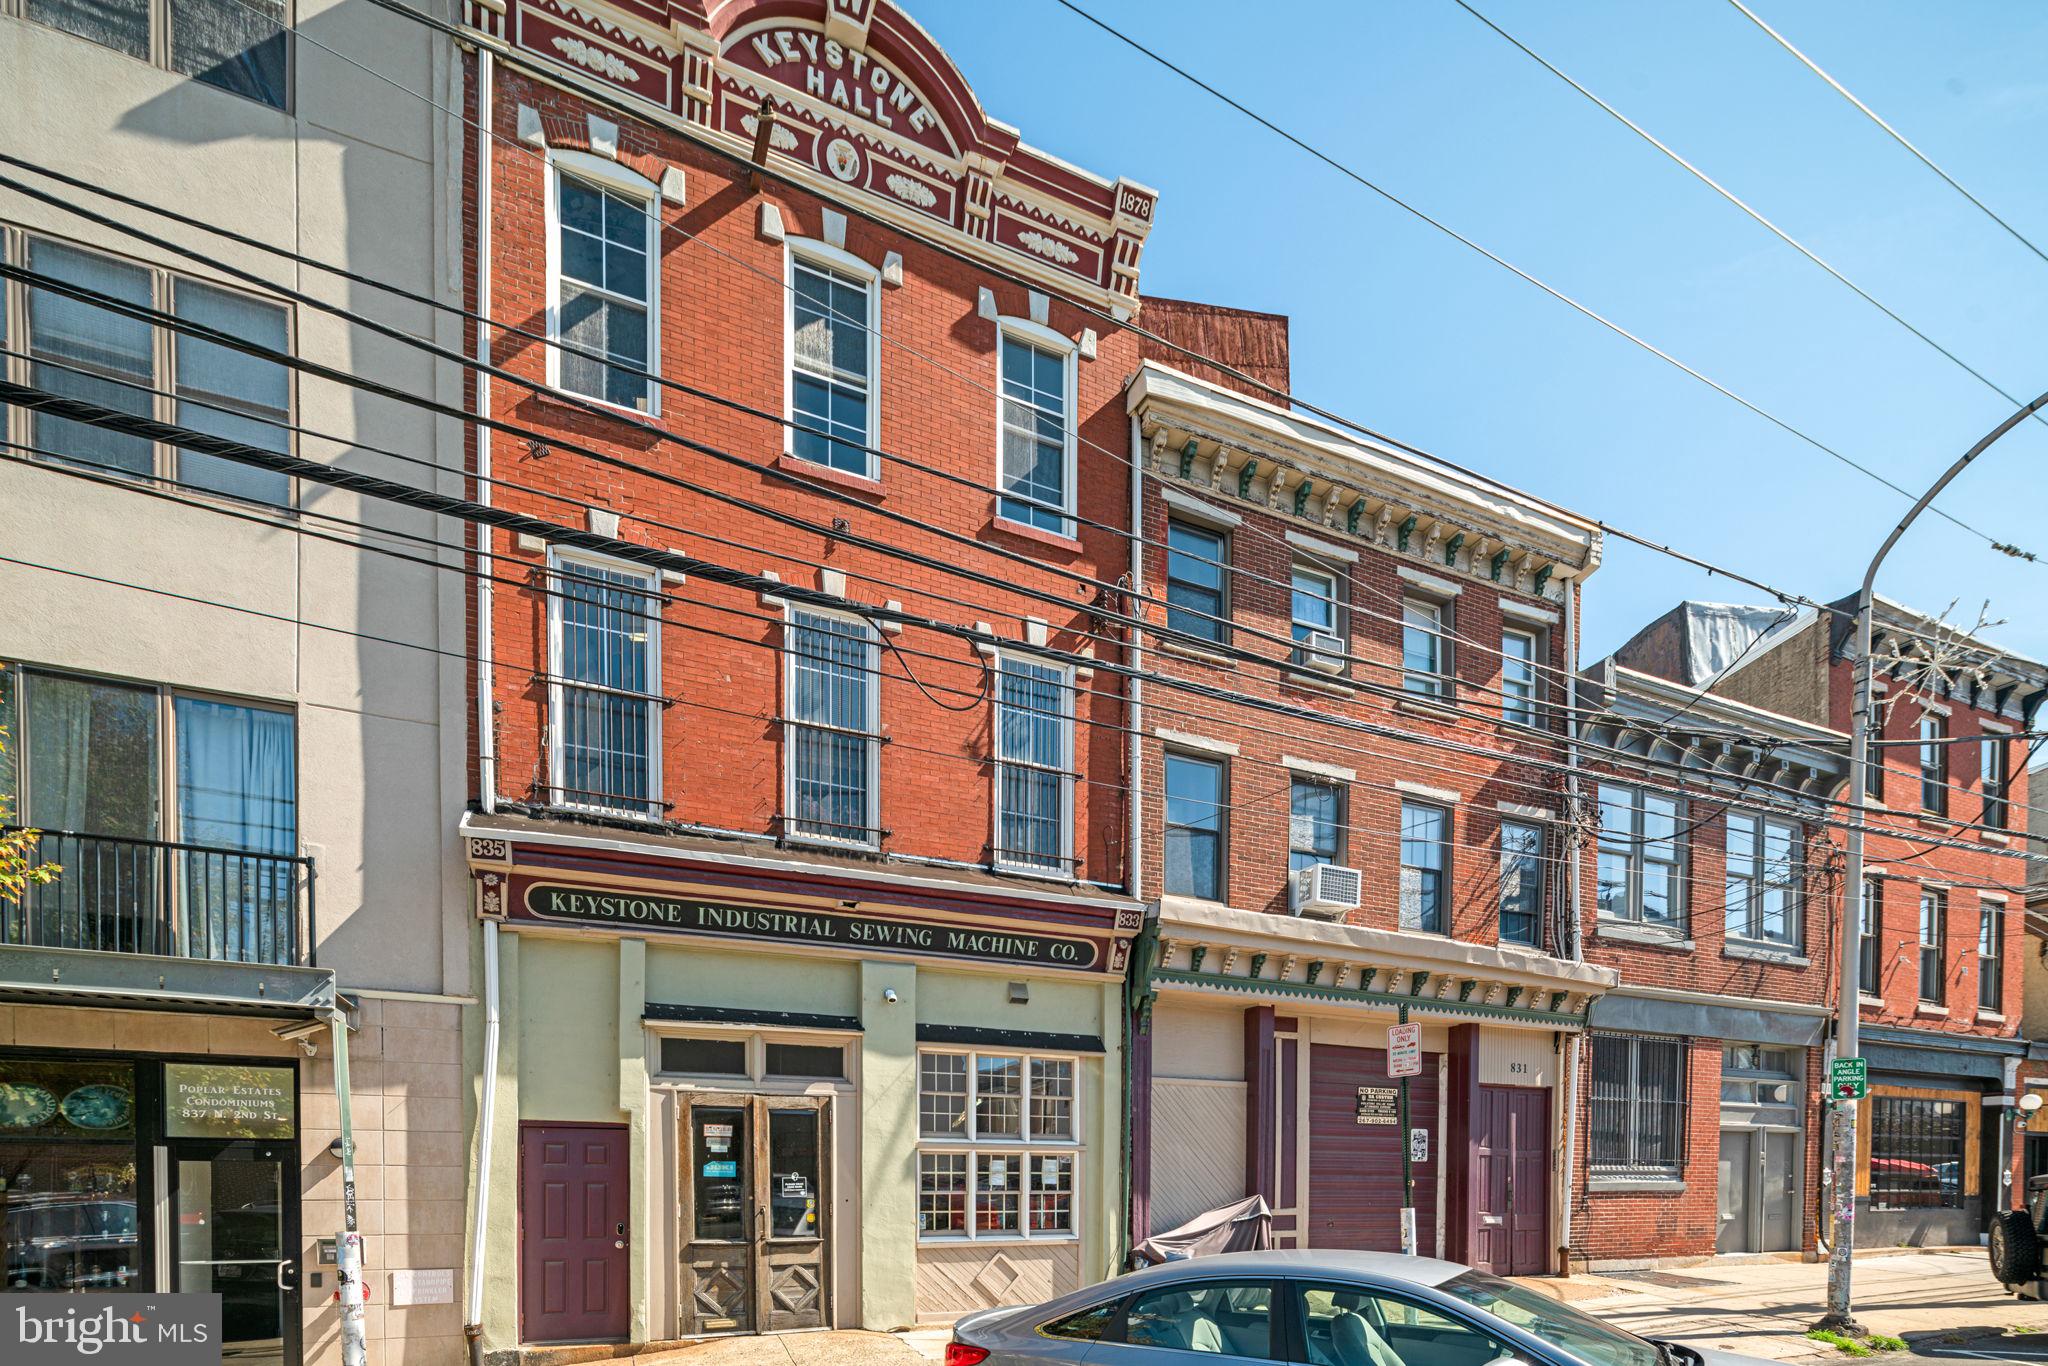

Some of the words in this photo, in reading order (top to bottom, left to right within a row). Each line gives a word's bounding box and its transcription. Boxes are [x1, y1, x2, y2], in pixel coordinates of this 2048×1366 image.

[752, 31, 936, 134] KEYSTONE
[806, 65, 893, 129] HALL
[1121, 191, 1150, 217] 1878
[471, 838, 505, 857] 835
[550, 892, 682, 923] KEYSTONE
[698, 906, 837, 938] INDUSTRIAL
[850, 922, 933, 947] SEWING
[947, 932, 1039, 957] MACHINE
[1050, 943, 1079, 962] CO.
[1119, 913, 1140, 928] 833
[1391, 1026, 1416, 1036] LOADING
[1396, 1034, 1411, 1043] ONLY
[1510, 1062, 1527, 1074] 831
[182, 1109, 207, 1118] 837
[214, 1110, 226, 1119] N.
